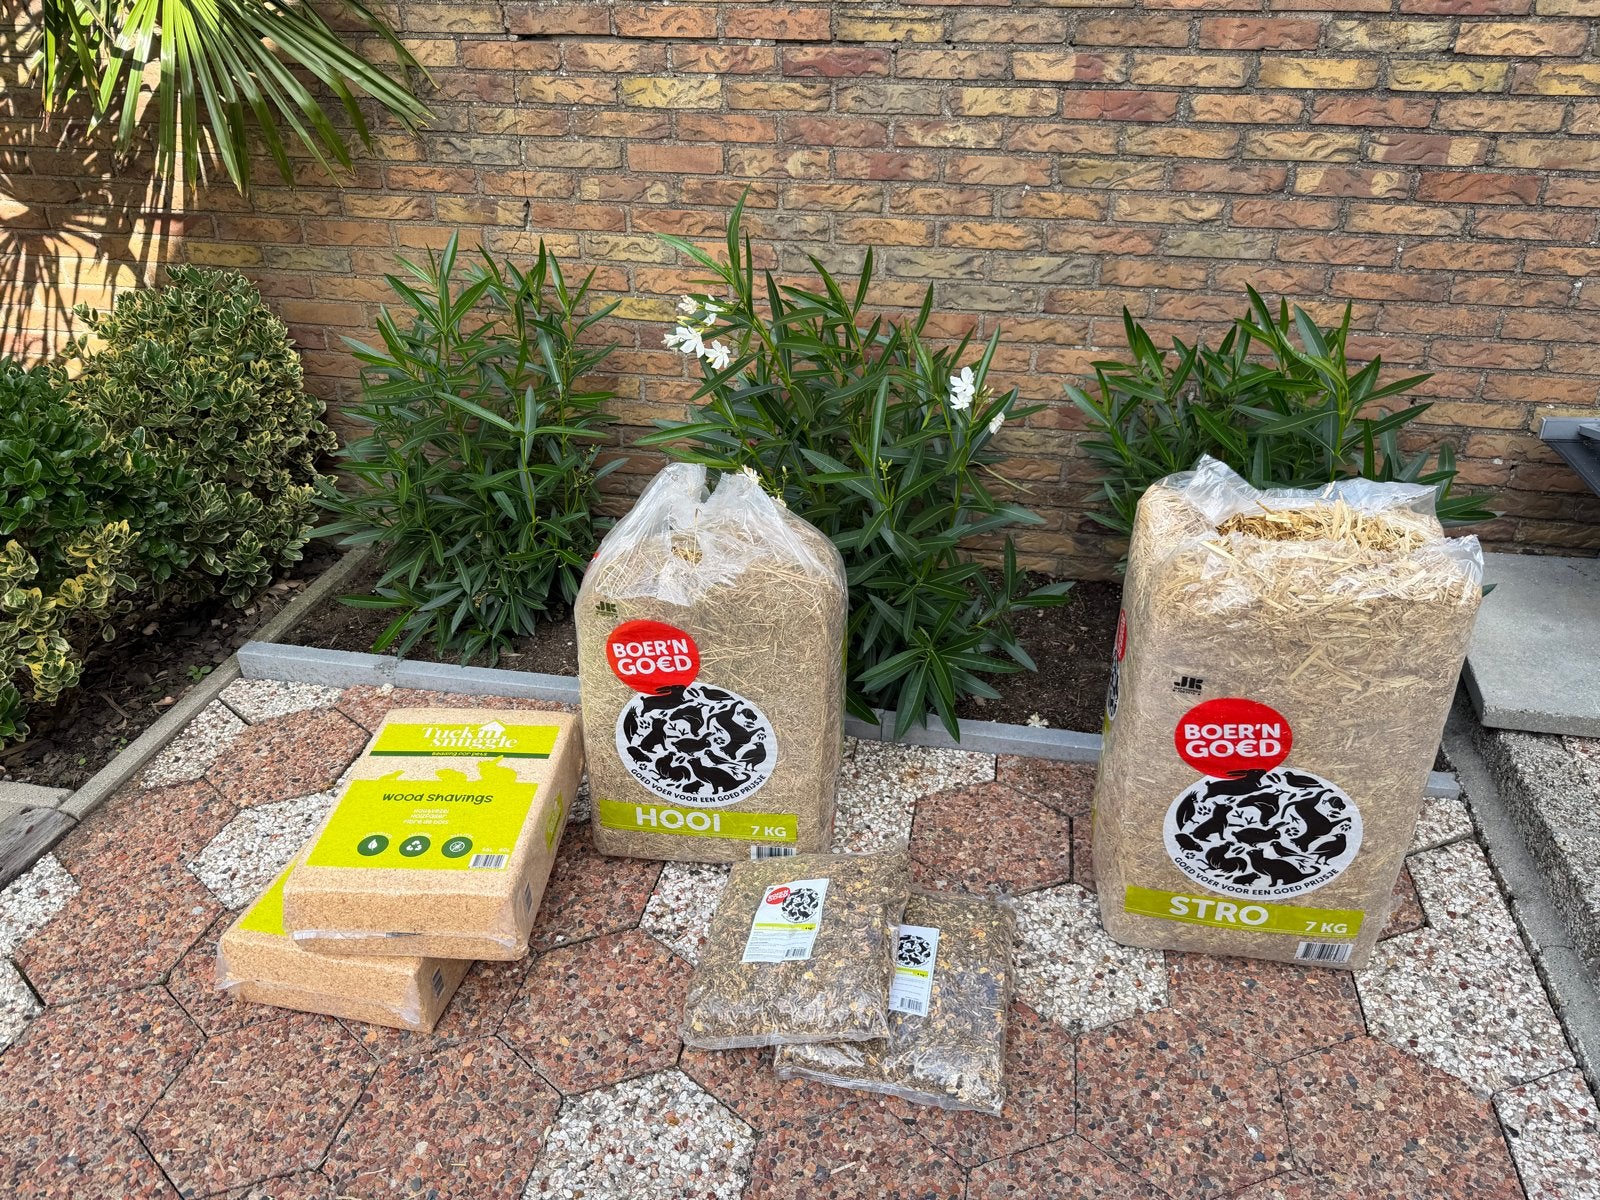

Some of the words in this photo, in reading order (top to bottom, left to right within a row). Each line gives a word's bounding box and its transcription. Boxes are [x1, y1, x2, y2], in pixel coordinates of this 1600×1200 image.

[612, 638, 689, 658] BOER'N
[422, 726, 474, 739] Tuck
[1184, 723, 1280, 740] BOER'N
[430, 735, 518, 750] snuggle
[630, 768, 651, 786] GOED
[651, 784, 673, 797] VOER
[674, 793, 698, 803] VOOR
[717, 791, 741, 802] GOED
[740, 774, 767, 795] PRIJSJE
[382, 793, 424, 802] wood
[426, 793, 494, 805] shavings
[635, 806, 721, 832] HOOI
[751, 826, 760, 836] 7
[764, 826, 787, 838] KG
[1174, 857, 1195, 875] GOED
[1195, 872, 1220, 888] VOER
[1221, 883, 1250, 895] VOOR
[1273, 884, 1303, 895] GOED
[1304, 868, 1340, 889] PRIJSJE
[1169, 895, 1270, 926] STRO
[1304, 921, 1317, 932] 7
[1320, 922, 1349, 934] KG
